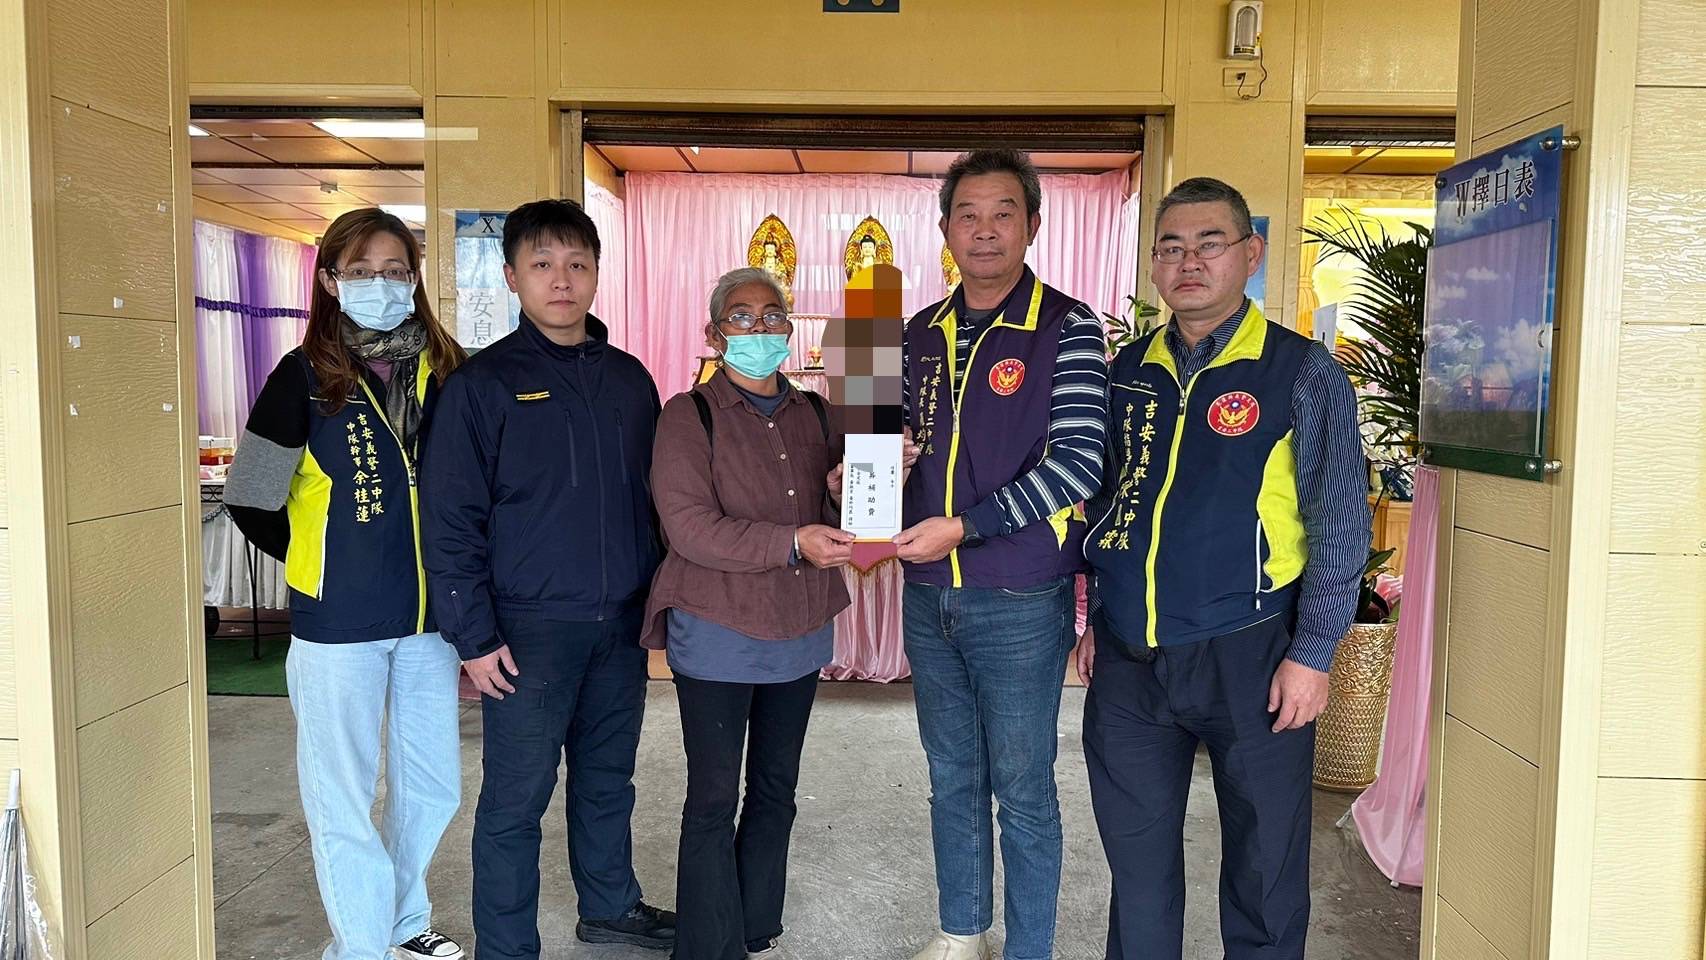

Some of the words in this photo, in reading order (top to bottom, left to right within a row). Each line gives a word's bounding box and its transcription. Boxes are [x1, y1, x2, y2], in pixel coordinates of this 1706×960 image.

[482, 217, 496, 233] X
[1454, 161, 1535, 217] W擇日表
[469, 291, 495, 346] 安息
[346, 421, 371, 522] 中隊幹事余桂蓮
[357, 413, 385, 515] 吉安義警二中隊
[1114, 399, 1159, 550] 吉安義警二中隊
